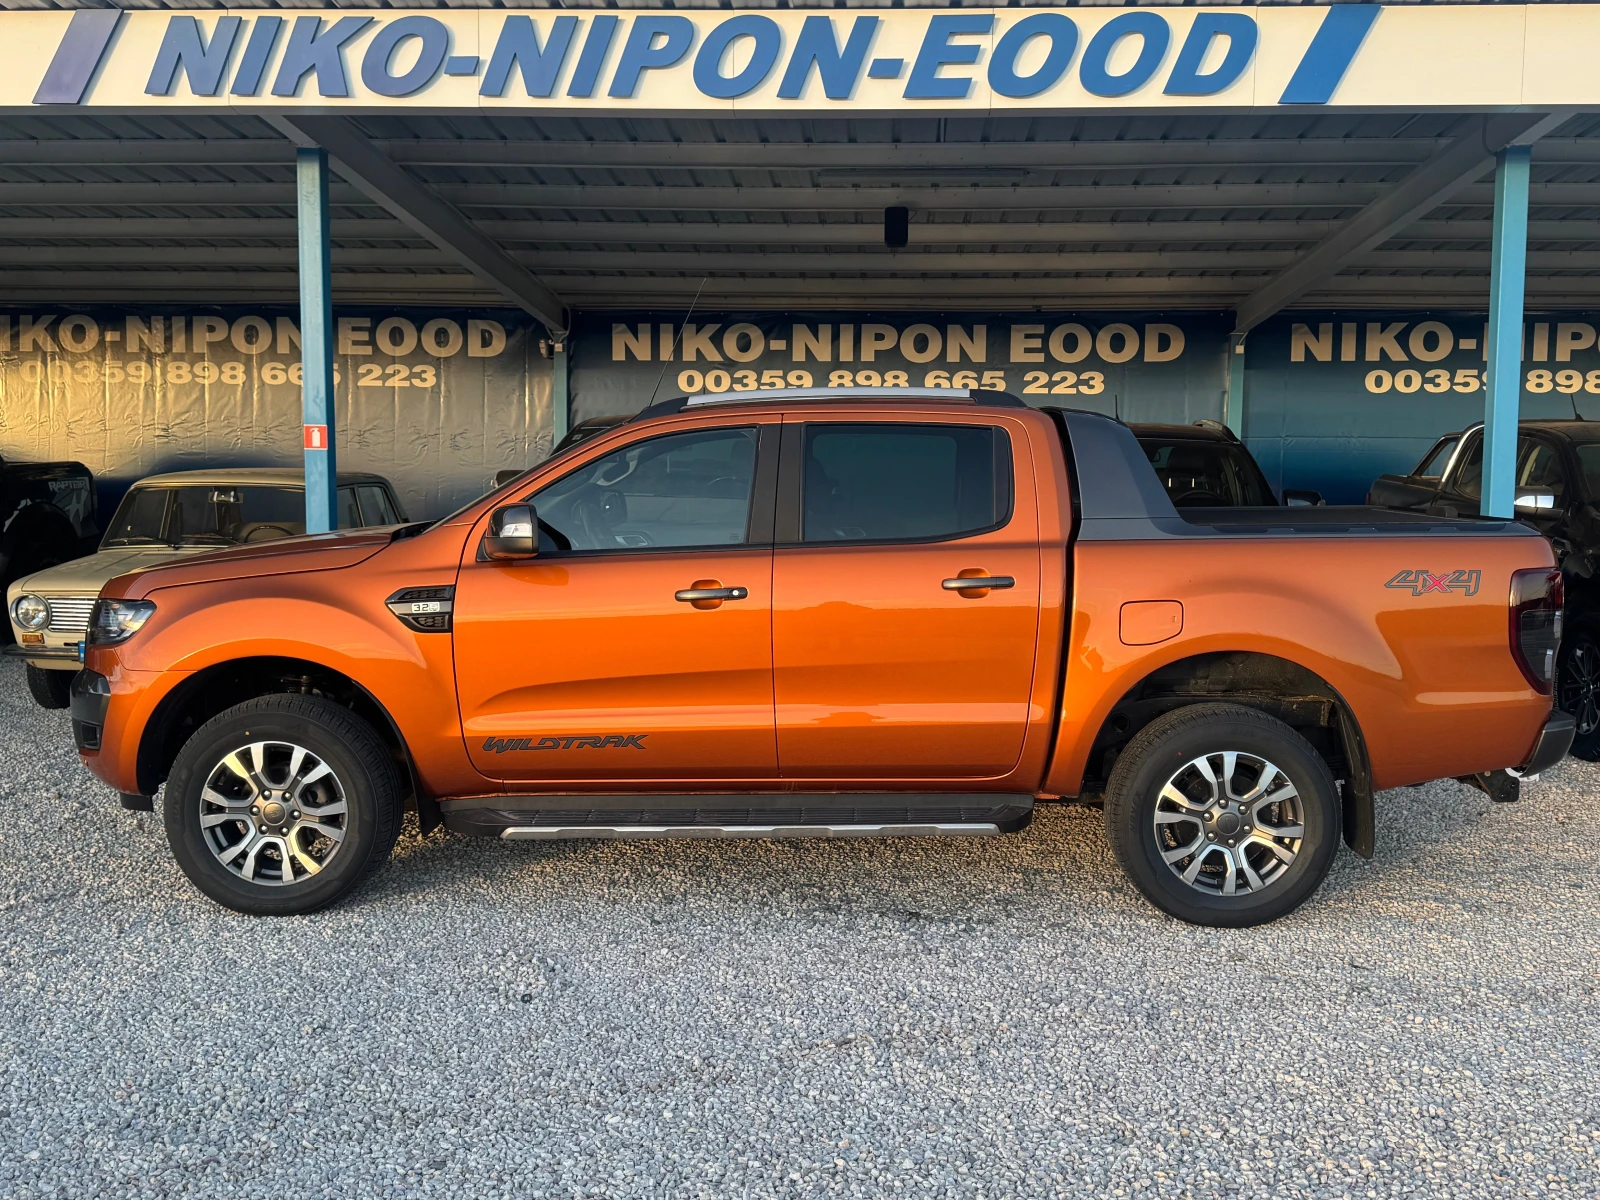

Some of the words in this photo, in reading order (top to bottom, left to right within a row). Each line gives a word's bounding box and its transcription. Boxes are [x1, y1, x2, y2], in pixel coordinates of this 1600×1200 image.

[144, 13, 1258, 98] NIKO-NIPON-EOOD
[338, 316, 507, 358] EOOD
[611, 322, 988, 363] NIKO-NIPON
[1010, 322, 1186, 364] EOOD
[1290, 321, 1600, 362] NIKO-IP
[20, 360, 153, 384] 00359
[166, 361, 247, 385] 898
[357, 363, 438, 388] 223
[677, 369, 814, 393] 00359
[828, 370, 910, 388] 898
[924, 370, 1007, 392] 665
[1022, 371, 1105, 395] 223
[1364, 369, 1487, 394] 0035
[48, 480, 87, 492] RAPTOR
[482, 734, 649, 754] WILDTRAK
